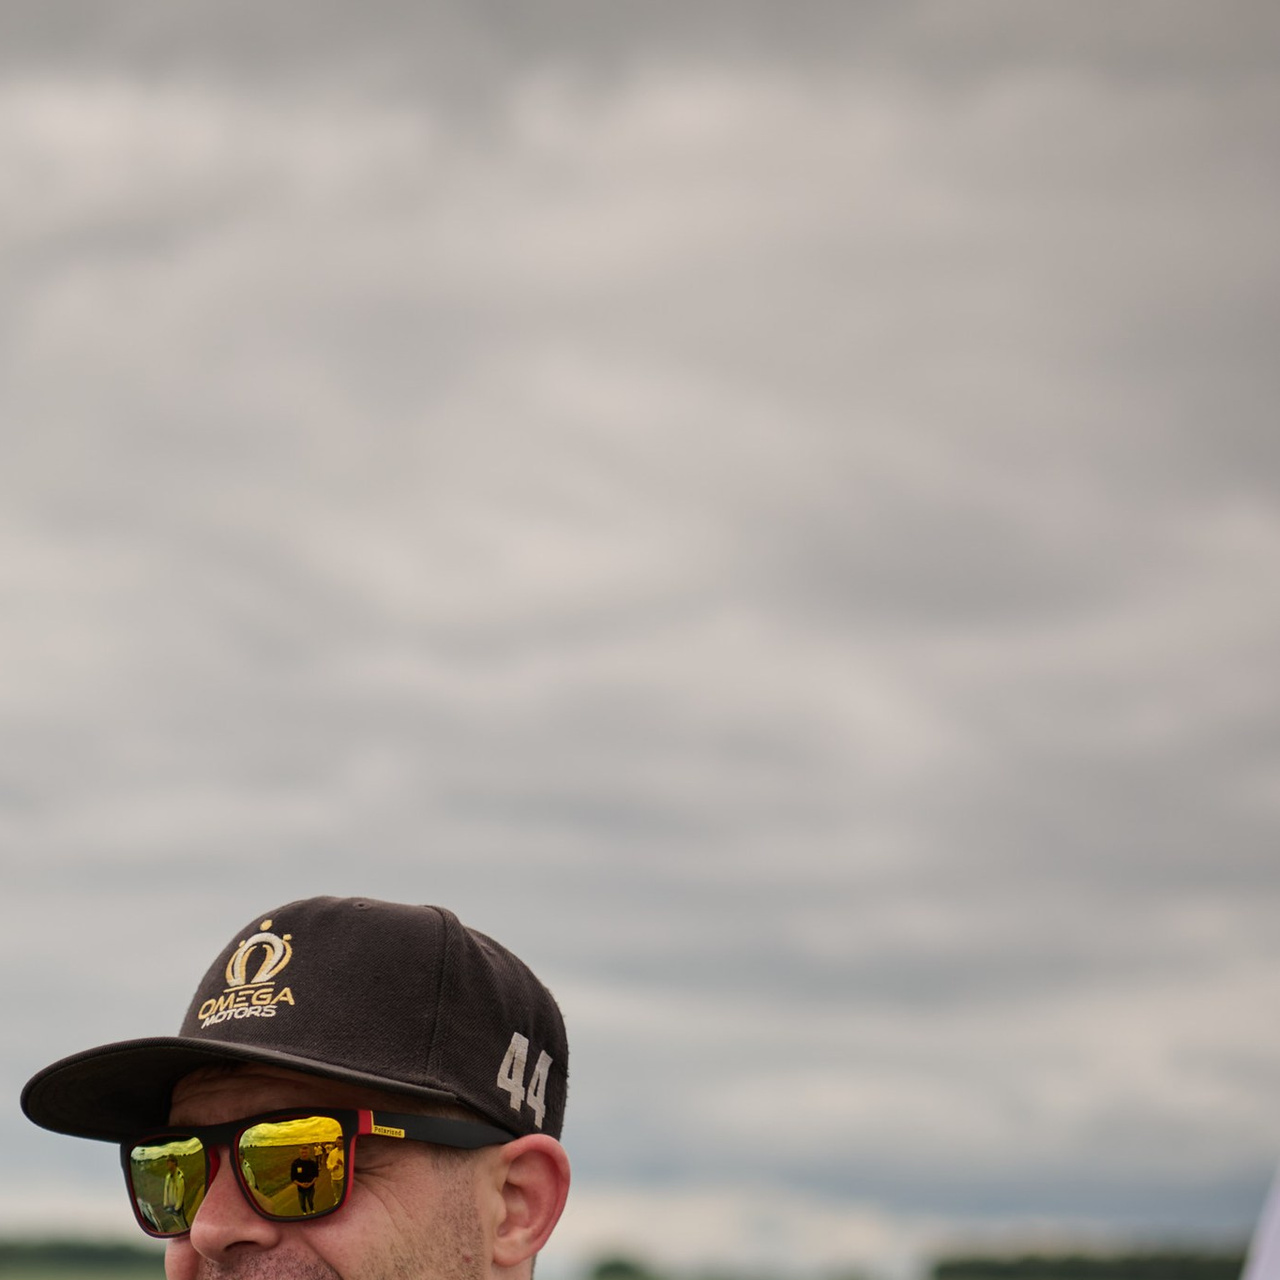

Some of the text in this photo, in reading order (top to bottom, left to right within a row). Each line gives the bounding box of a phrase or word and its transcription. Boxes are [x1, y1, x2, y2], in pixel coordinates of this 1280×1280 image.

[198, 986, 295, 1020] OMEGA
[201, 1004, 277, 1029] MOTORS
[496, 1031, 554, 1129] 44
